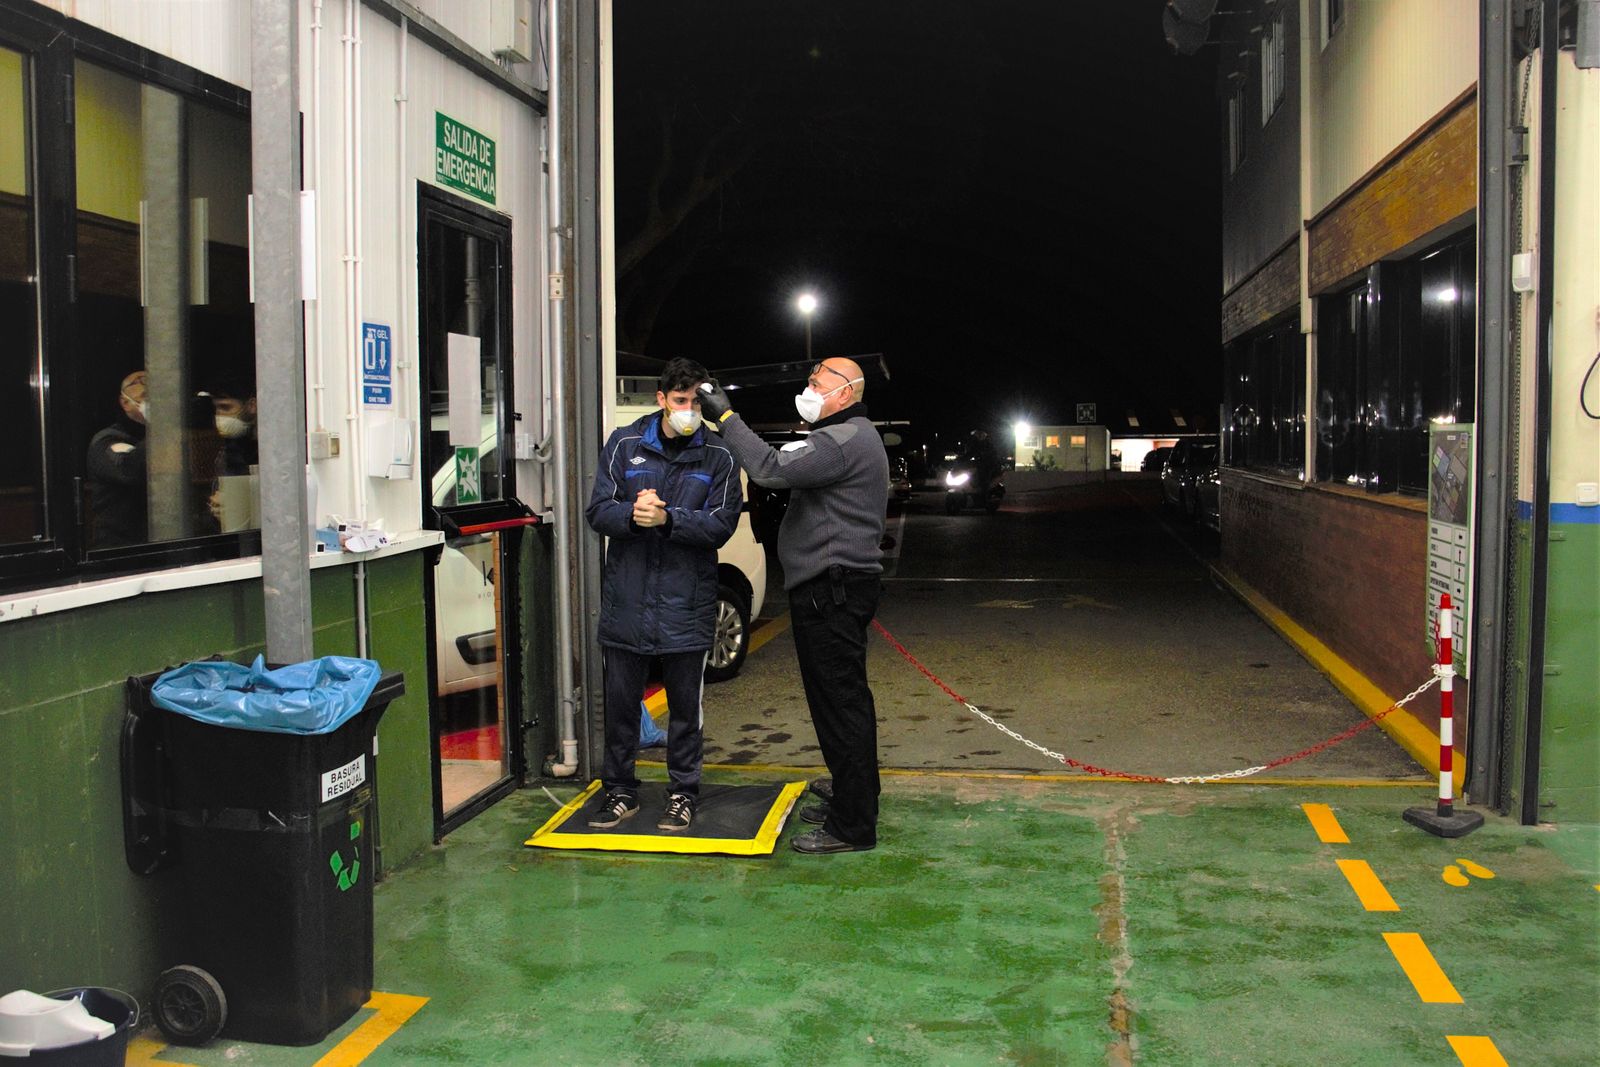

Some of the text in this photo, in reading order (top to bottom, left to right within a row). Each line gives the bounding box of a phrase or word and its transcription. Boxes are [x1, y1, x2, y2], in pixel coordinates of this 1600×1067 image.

[444, 121, 491, 167] SALIDA DE
[436, 147, 496, 197] EMERGENCIA
[377, 329, 388, 340] GEL
[327, 772, 363, 798] RESIDUAL
[330, 761, 360, 784] BASURA
